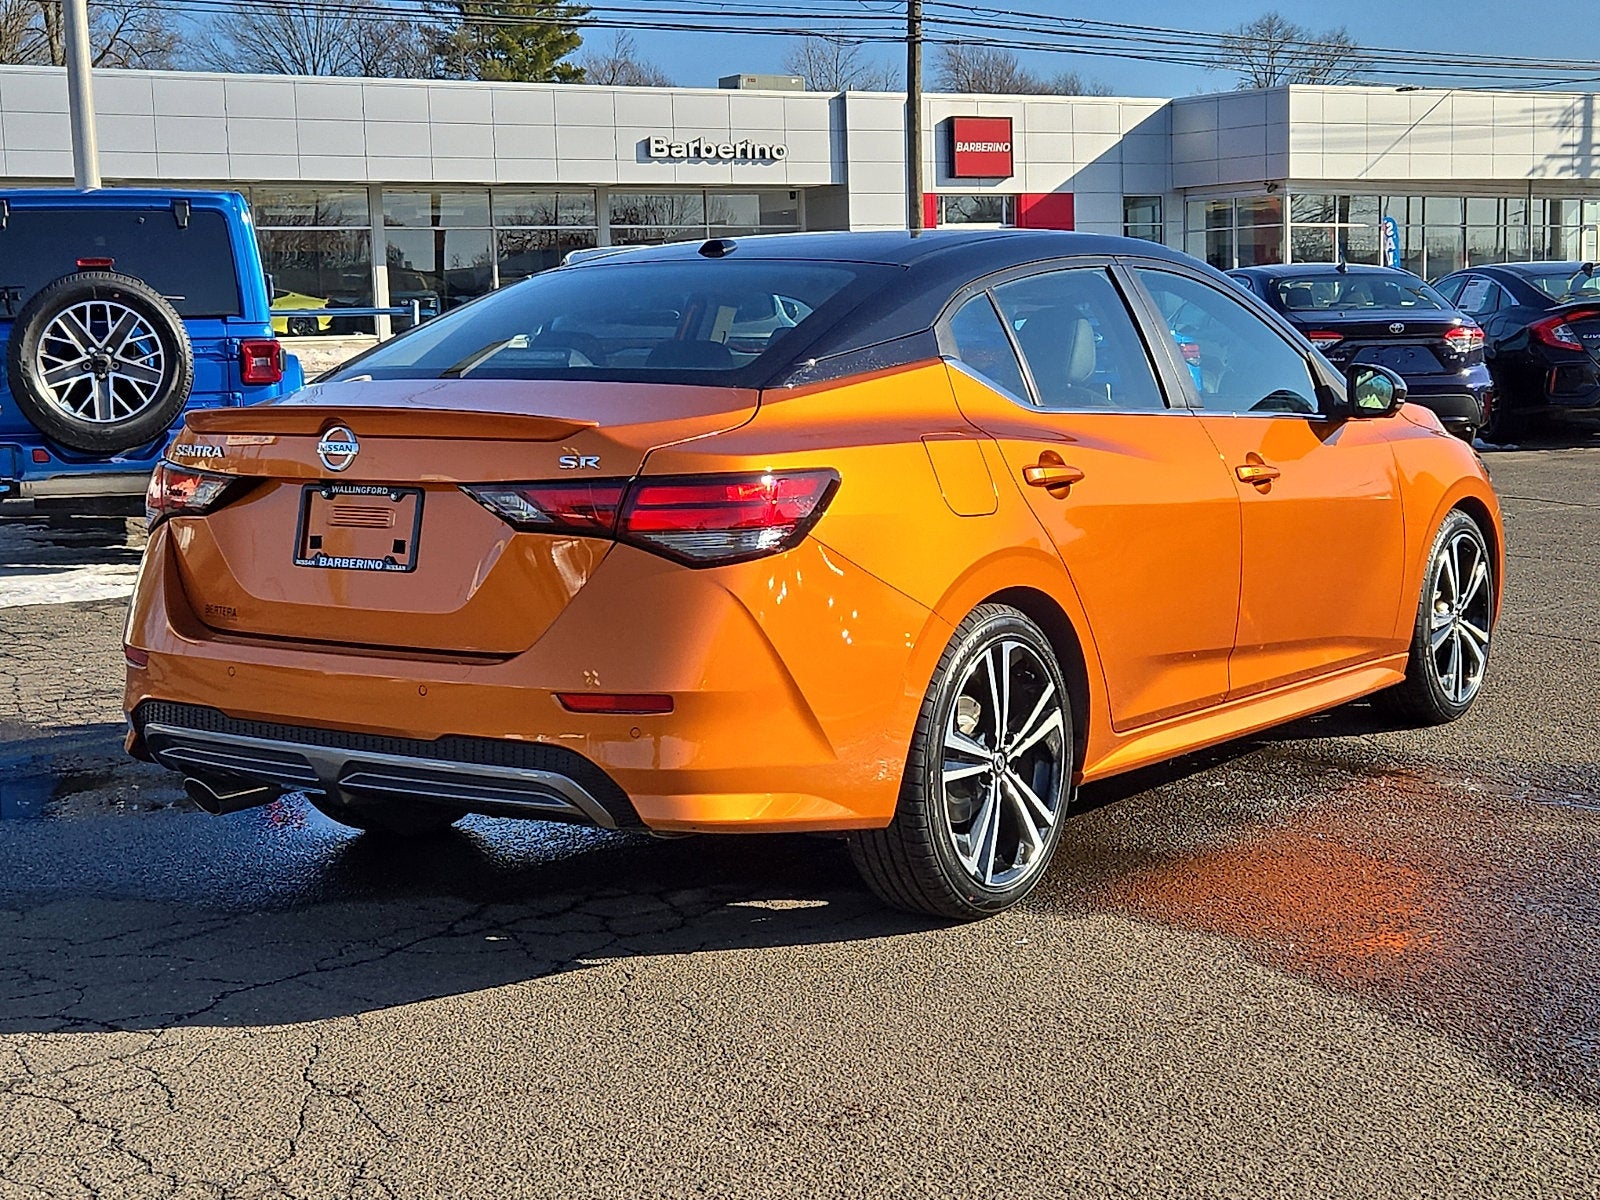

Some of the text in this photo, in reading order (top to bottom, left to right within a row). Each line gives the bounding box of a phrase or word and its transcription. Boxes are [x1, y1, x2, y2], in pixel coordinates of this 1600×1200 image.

[649, 136, 788, 160] Barberino
[956, 142, 1011, 153] BARBERINO
[175, 444, 223, 458] SENTRA
[559, 456, 601, 469] SR
[331, 485, 388, 494] WALLINGFORD
[319, 557, 383, 570] BARBERINO
